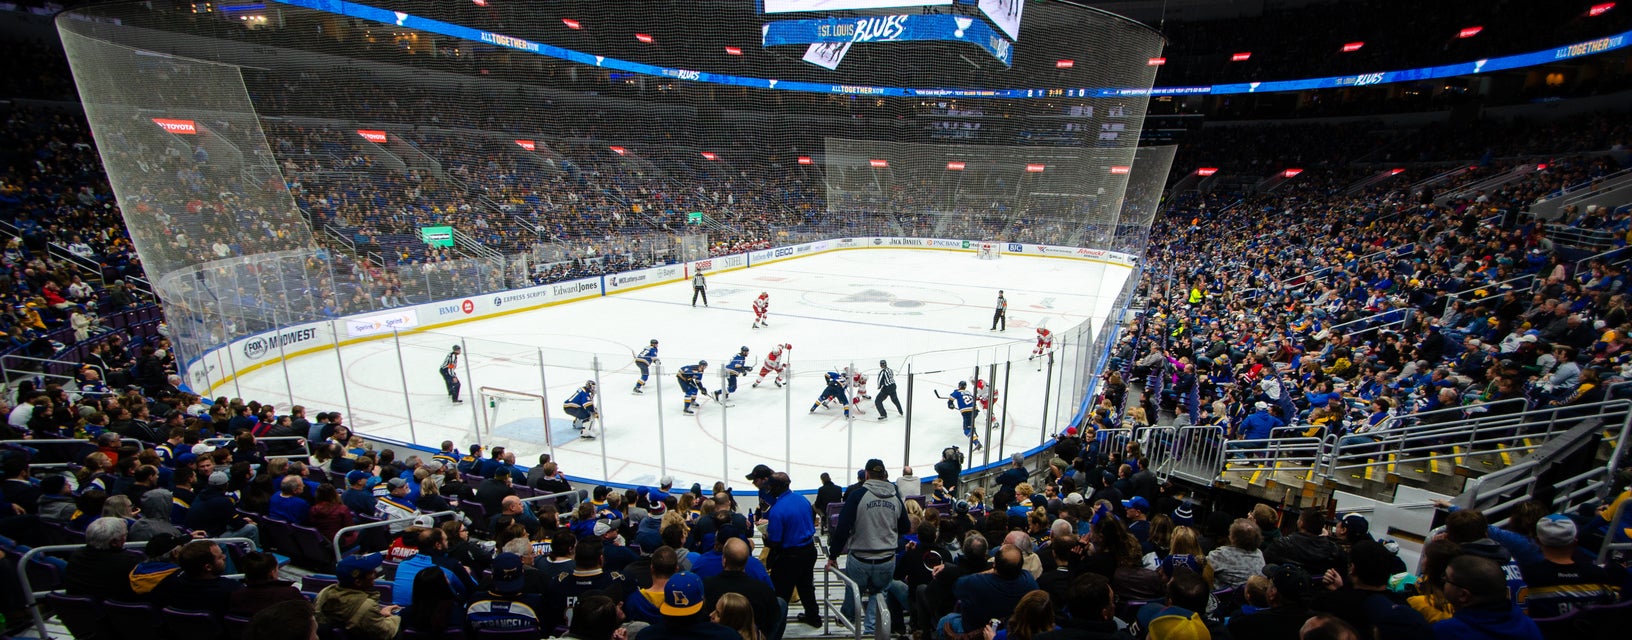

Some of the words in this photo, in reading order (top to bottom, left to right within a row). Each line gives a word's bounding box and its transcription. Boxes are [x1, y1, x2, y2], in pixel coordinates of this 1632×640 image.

[821, 25, 832, 37] ST.
[833, 24, 854, 37] LOUIS
[852, 14, 909, 42] BLUES
[678, 69, 701, 81] BLUES
[1354, 72, 1386, 87] BLUES
[1027, 89, 1033, 97] 2
[1079, 88, 1085, 97] 0
[166, 123, 195, 131] TOYOTA
[890, 238, 901, 246] JACK
[774, 247, 793, 258] GEICO
[1009, 243, 1022, 252] BJC
[724, 257, 743, 268] STIFEL
[503, 294, 526, 303] EXPRESS
[527, 290, 546, 300] SCRIPTS
[439, 305, 460, 315] BMO
[385, 317, 403, 327] Sprint
[355, 324, 374, 332] Sprint
[248, 340, 262, 352] FOX
[269, 328, 316, 350] MIDWEST
[866, 499, 882, 510] MIKE
